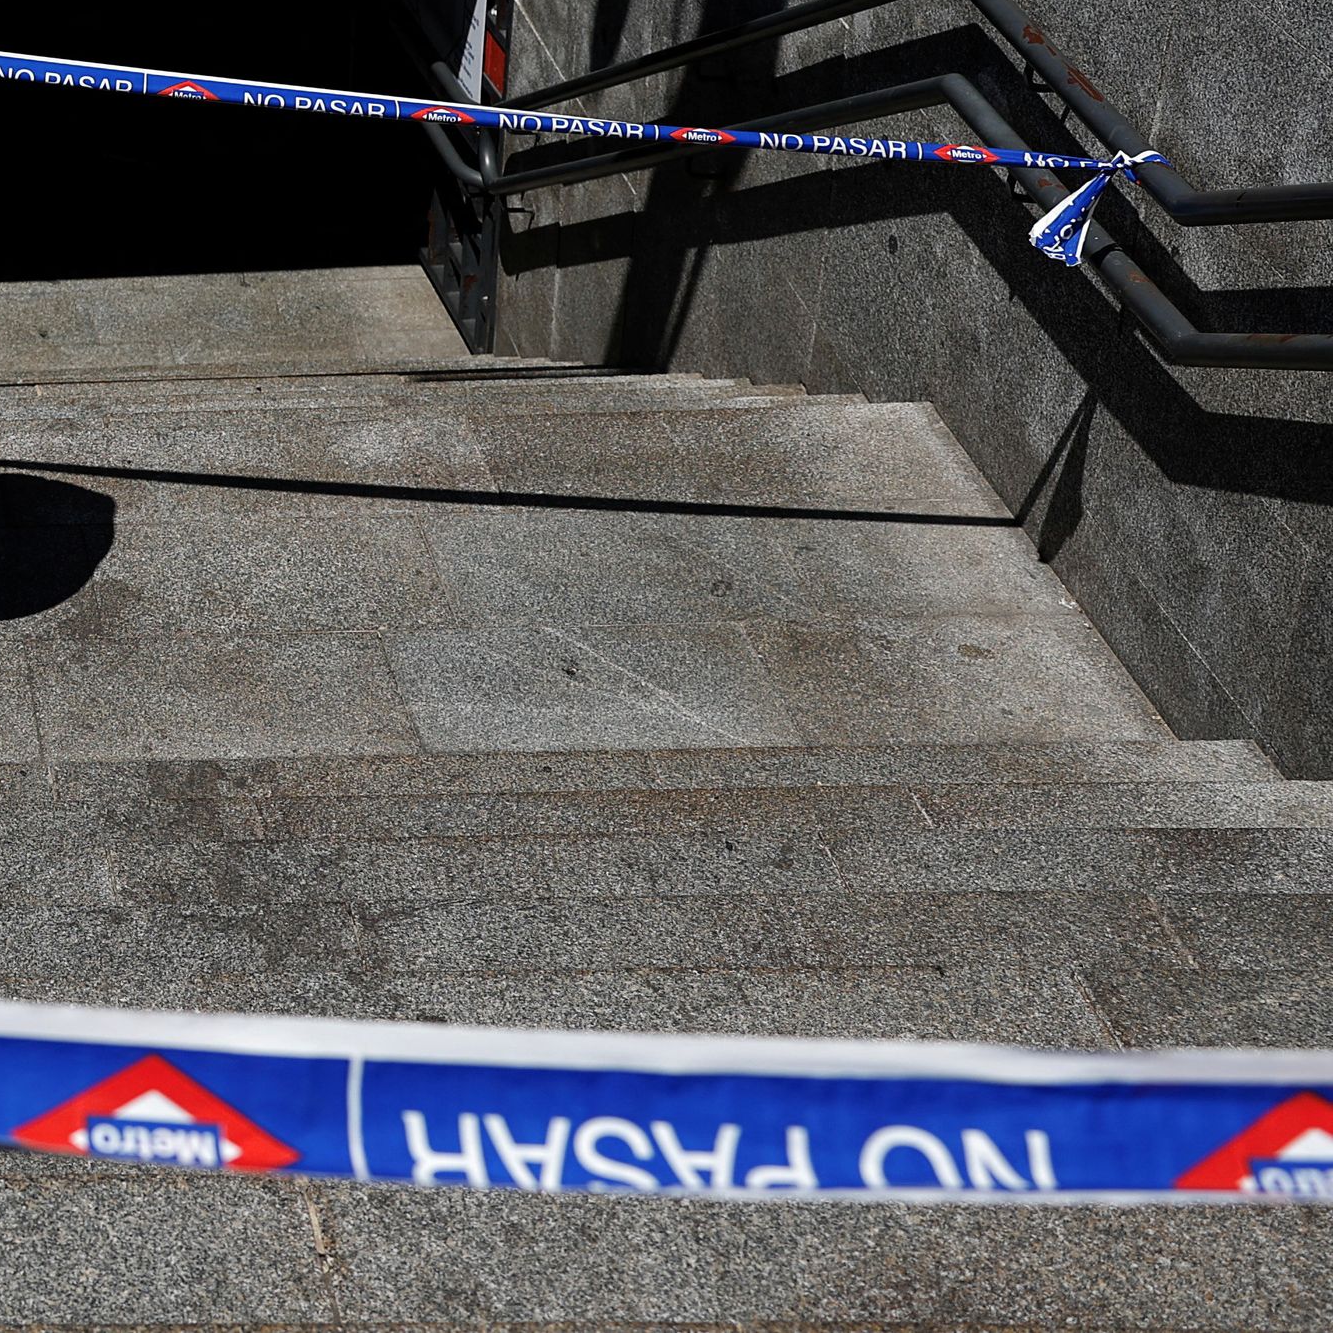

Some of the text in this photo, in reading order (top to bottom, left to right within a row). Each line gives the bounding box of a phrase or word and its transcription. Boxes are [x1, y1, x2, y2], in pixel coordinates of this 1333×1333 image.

[244, 91, 386, 119] NO PASAR
[428, 111, 457, 123] Metro
[499, 113, 644, 140] NO PASAR
[687, 131, 717, 142] Metro
[759, 132, 907, 160] NO PASAR
[952, 149, 982, 160] Metro
[89, 1122, 217, 1167] Metro
